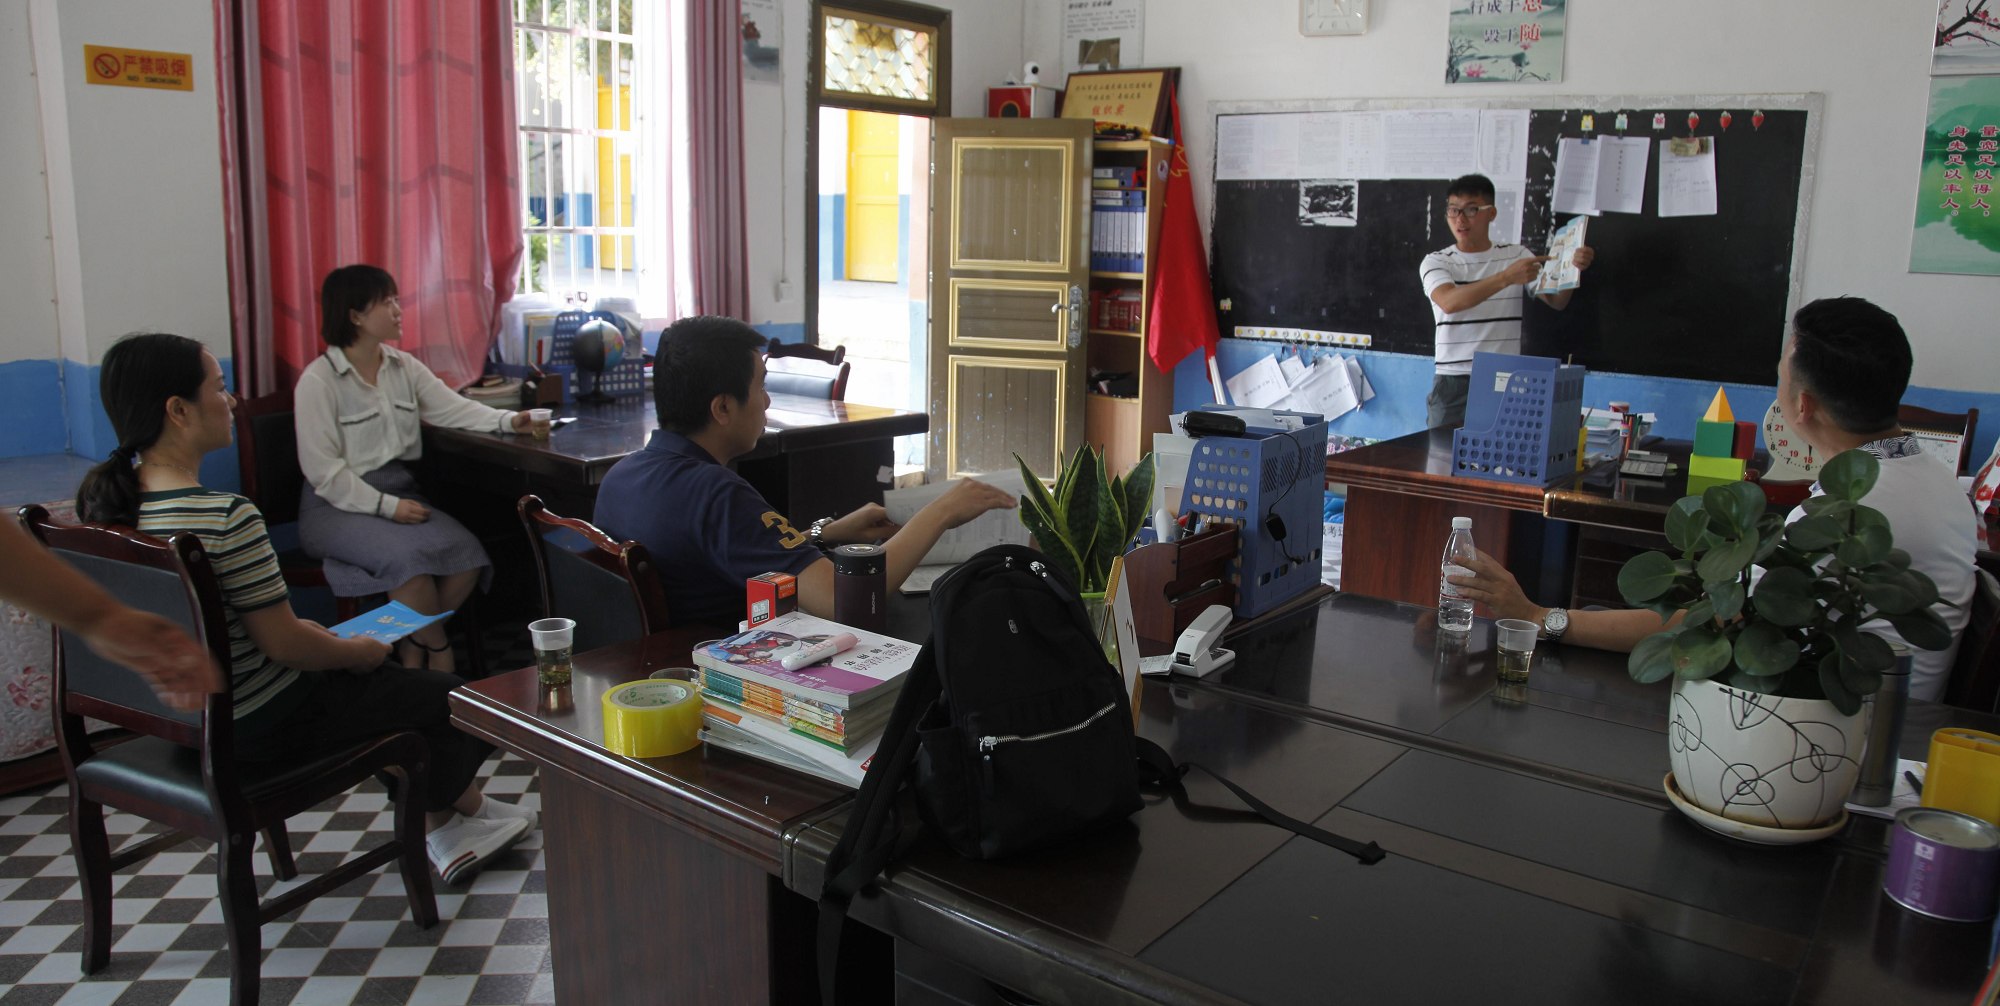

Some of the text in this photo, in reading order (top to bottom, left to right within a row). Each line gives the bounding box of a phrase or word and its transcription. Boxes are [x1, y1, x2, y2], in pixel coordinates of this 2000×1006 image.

[123, 54, 186, 77] 严禁吸烟
[1772, 406, 1781, 414] 10
[1774, 424, 1784, 432] 21
[1770, 443, 1776, 451] 8
[1803, 456, 1813, 464] 18
[761, 511, 806, 549] 3
[753, 603, 767, 614] 0.5
